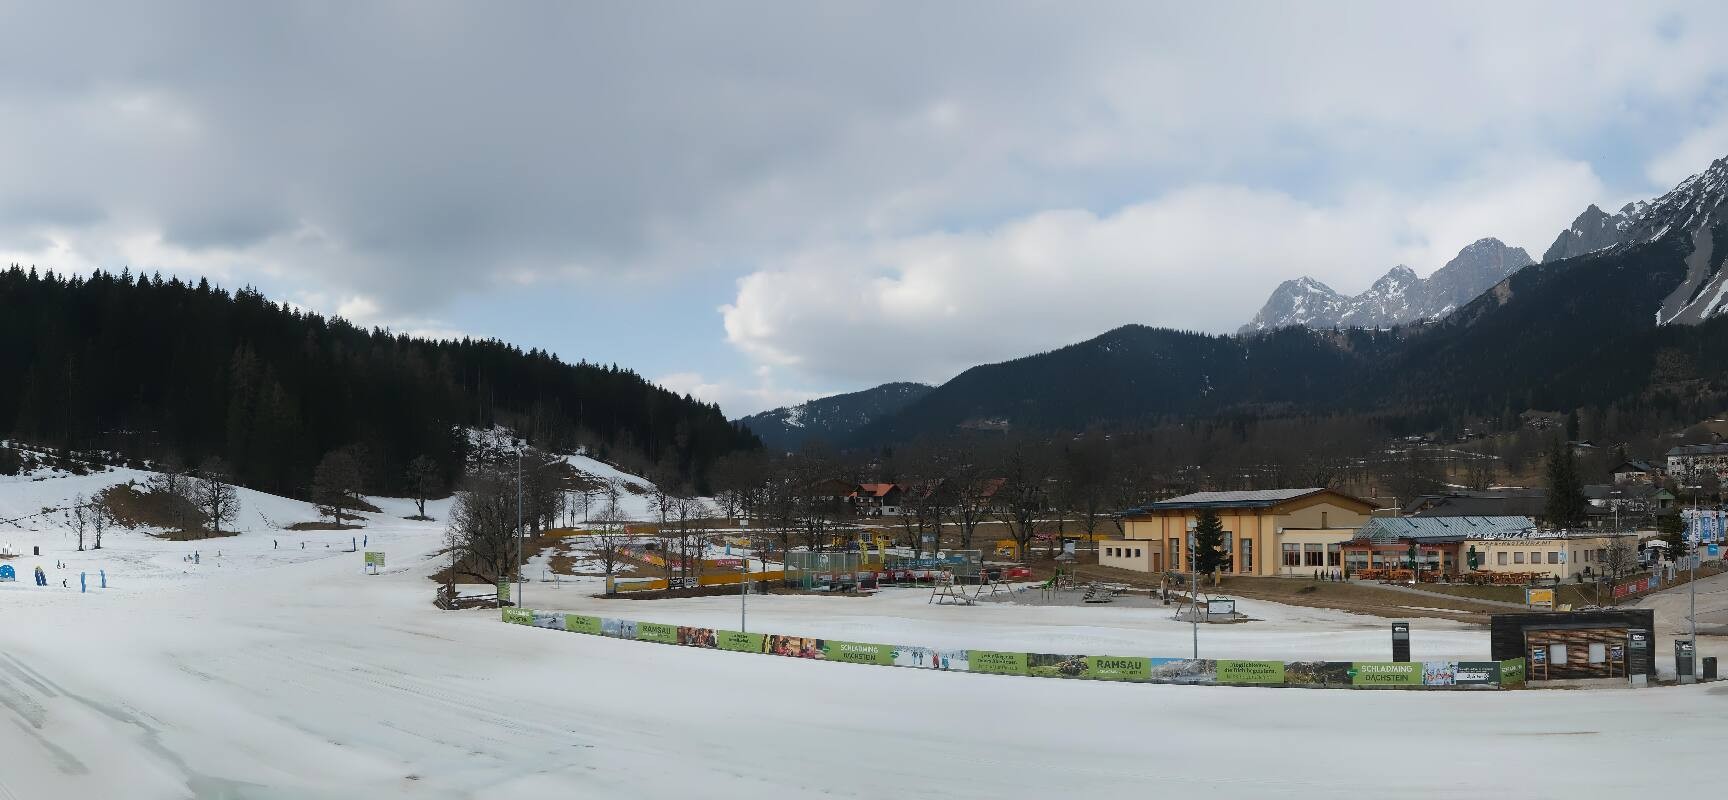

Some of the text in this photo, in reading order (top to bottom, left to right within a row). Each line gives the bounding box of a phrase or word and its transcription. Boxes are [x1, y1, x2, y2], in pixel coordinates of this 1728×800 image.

[642, 625, 671, 635] RAMSAU
[1096, 659, 1142, 670] RAMSAU
[1361, 665, 1413, 673] SCHLADMING
[1365, 673, 1409, 682] DACHSTEIN
